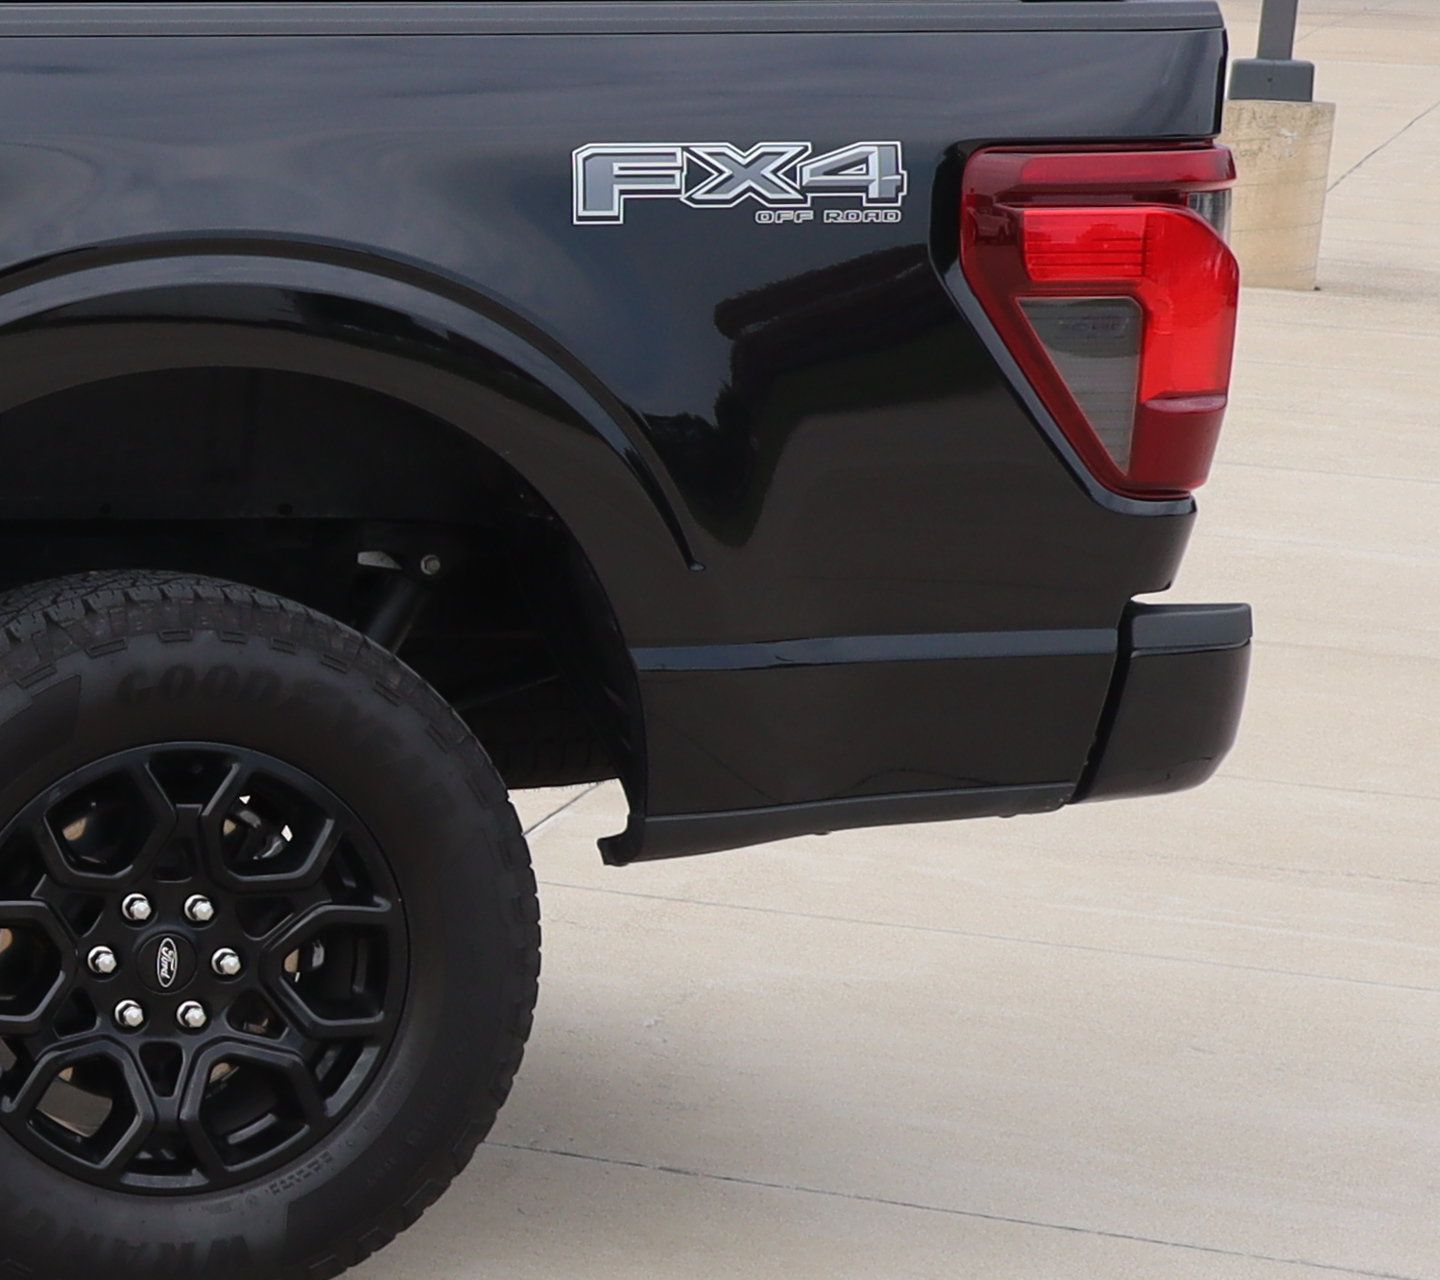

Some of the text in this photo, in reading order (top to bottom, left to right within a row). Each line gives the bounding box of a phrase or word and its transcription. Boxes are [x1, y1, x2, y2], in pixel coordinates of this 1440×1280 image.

[571, 141, 908, 224] FX4
[754, 209, 903, 224] OFF ROAD
